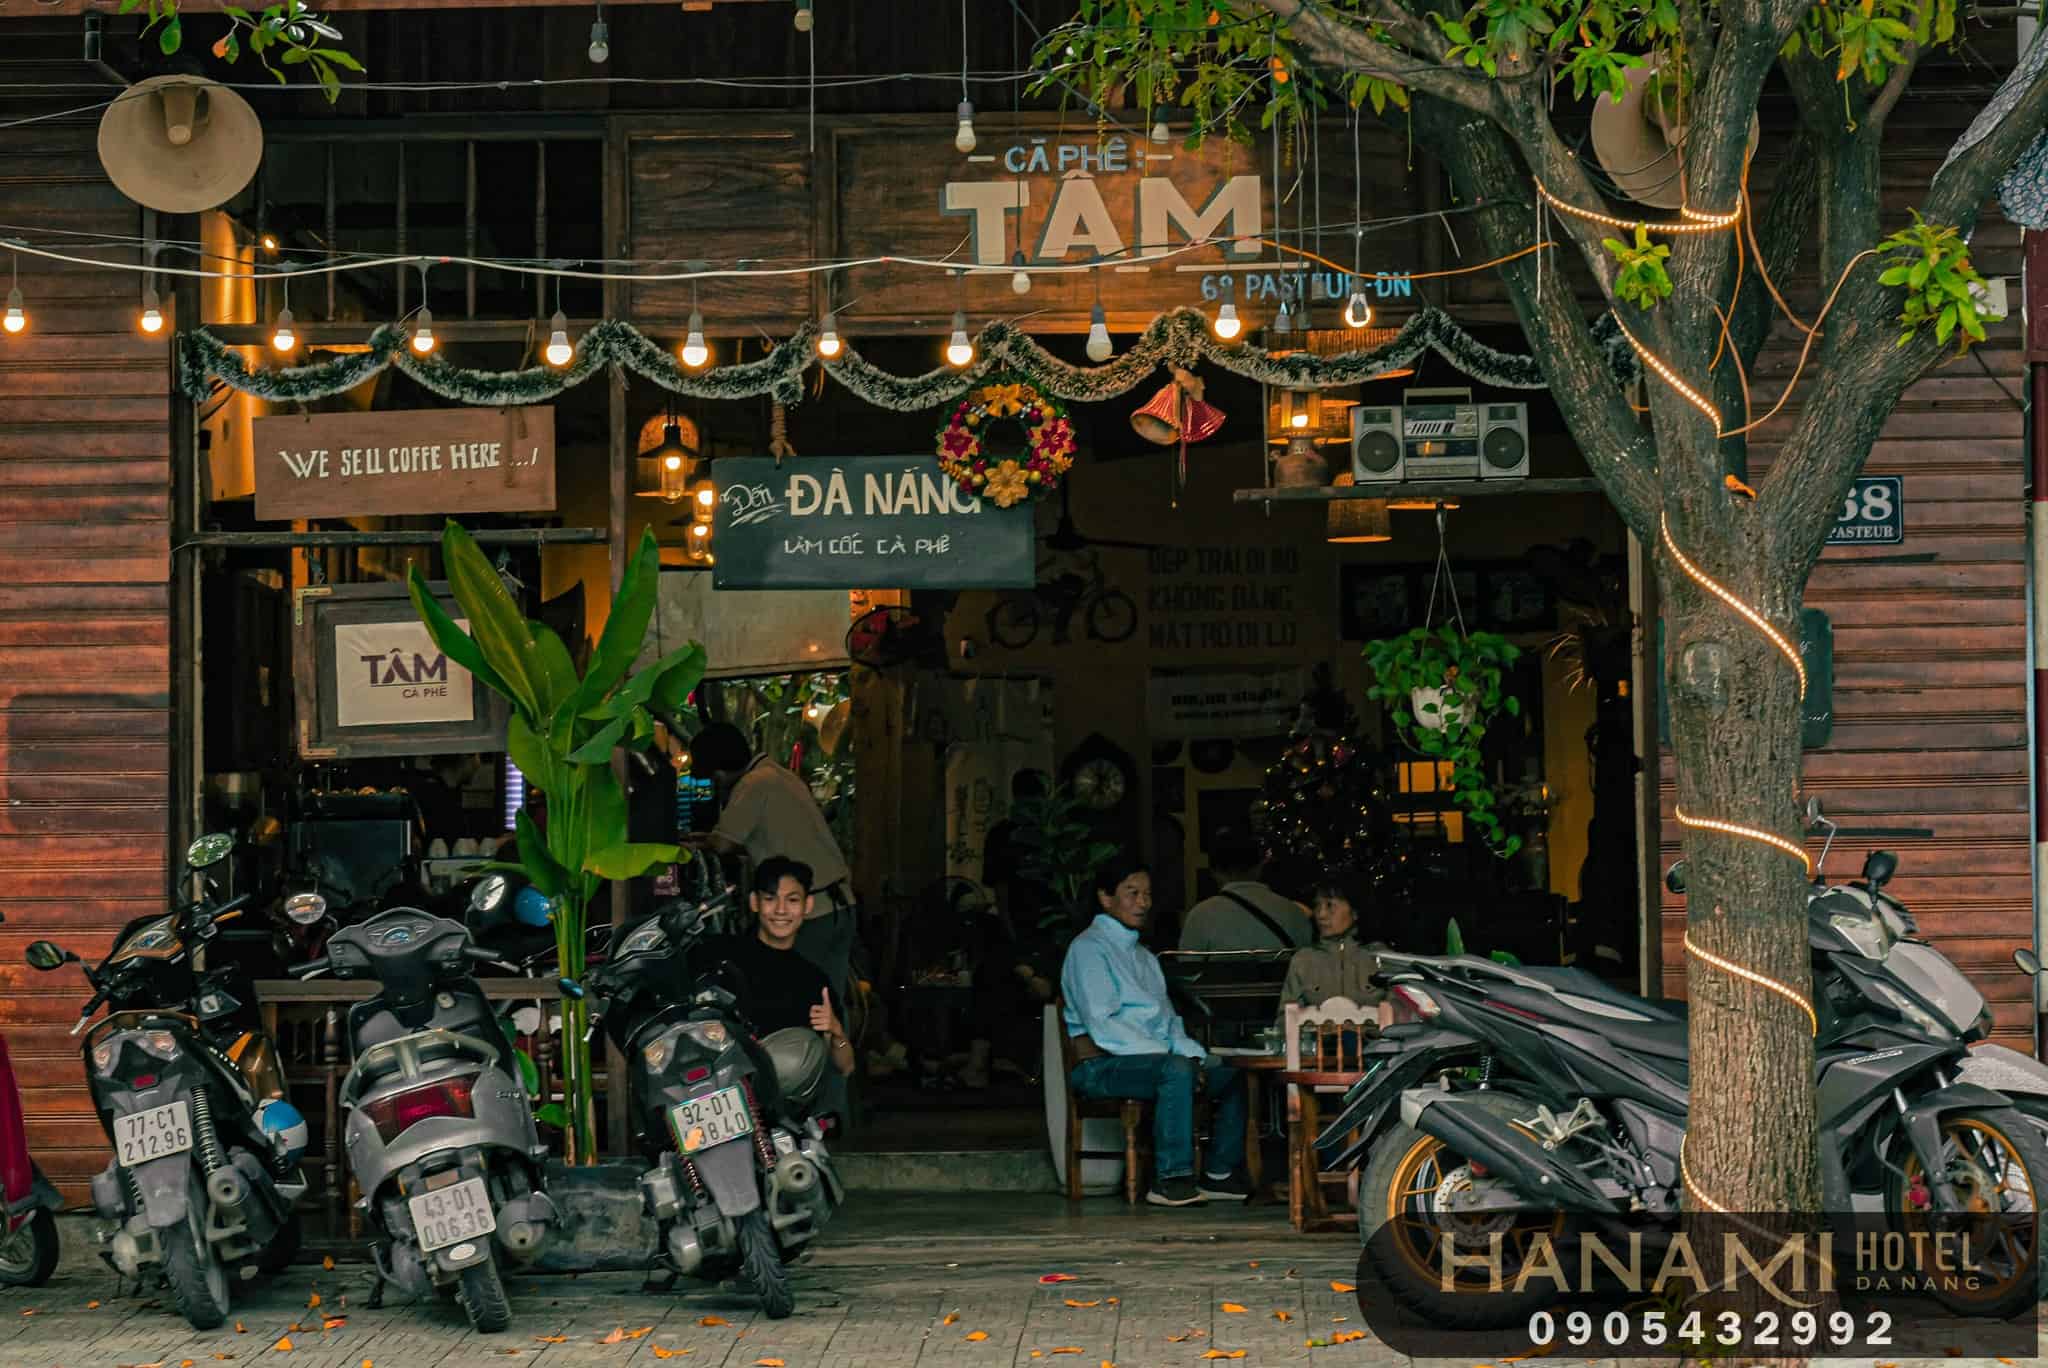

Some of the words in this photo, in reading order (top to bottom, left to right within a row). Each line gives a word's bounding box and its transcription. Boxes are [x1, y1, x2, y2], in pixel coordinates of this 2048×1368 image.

[942, 169, 1263, 265] TÂM
[279, 450, 329, 478] WE
[340, 448, 384, 476] SELL
[388, 445, 442, 473] COFFE
[450, 443, 501, 470] HERE
[785, 466, 853, 515] ĐÀ
[877, 535, 906, 554] CÀ
[361, 648, 448, 684] TÂM
